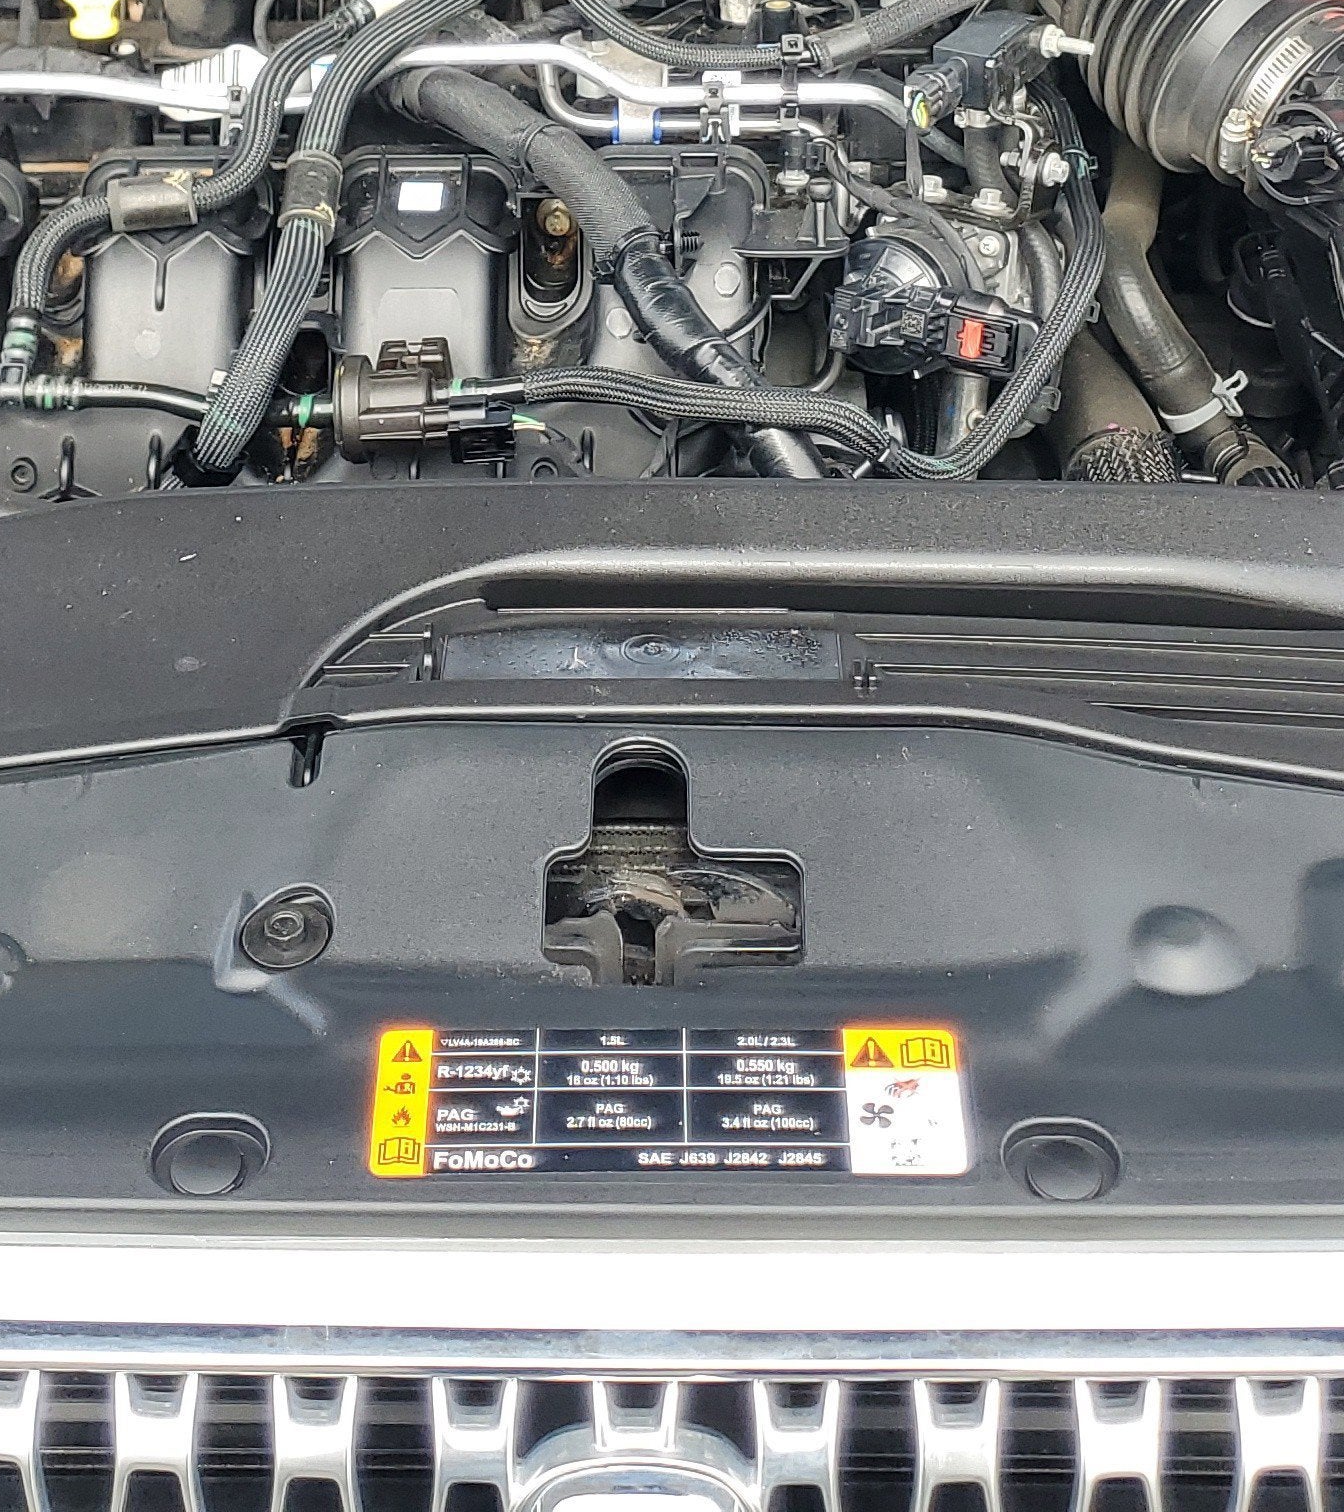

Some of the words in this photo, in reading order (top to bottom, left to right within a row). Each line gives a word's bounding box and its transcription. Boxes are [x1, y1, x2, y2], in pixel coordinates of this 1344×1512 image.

[600, 1035, 626, 1046] 1.5L
[736, 1035, 761, 1046] 2.0L
[770, 1036, 795, 1046] 2.3L
[437, 1064, 510, 1081] R-1234yf
[581, 1059, 618, 1073] 0.500
[621, 1059, 640, 1075] kg
[736, 1058, 773, 1072] 0.550
[776, 1058, 795, 1075] kg
[583, 1077, 599, 1086] oz
[600, 1074, 629, 1087] (1.10
[631, 1074, 654, 1087] lbs)
[744, 1076, 760, 1086] oz
[761, 1073, 790, 1087] (1.21
[792, 1074, 815, 1087] lbs)
[436, 1108, 474, 1122] PAG
[595, 1103, 624, 1114] PAG
[753, 1103, 782, 1115] PAG
[566, 1116, 586, 1128] 2.7
[587, 1116, 596, 1128] fl
[598, 1118, 614, 1128] oz
[616, 1115, 652, 1130] (80cc)
[721, 1116, 740, 1128] 3.4
[742, 1116, 751, 1128] fl
[753, 1118, 769, 1128] oz
[771, 1116, 814, 1131] (100cc)
[433, 1150, 533, 1171] FoMoCo
[637, 1152, 672, 1165] SAE
[678, 1151, 716, 1165] J639
[723, 1151, 769, 1165] J2842
[778, 1151, 824, 1165] J2845
